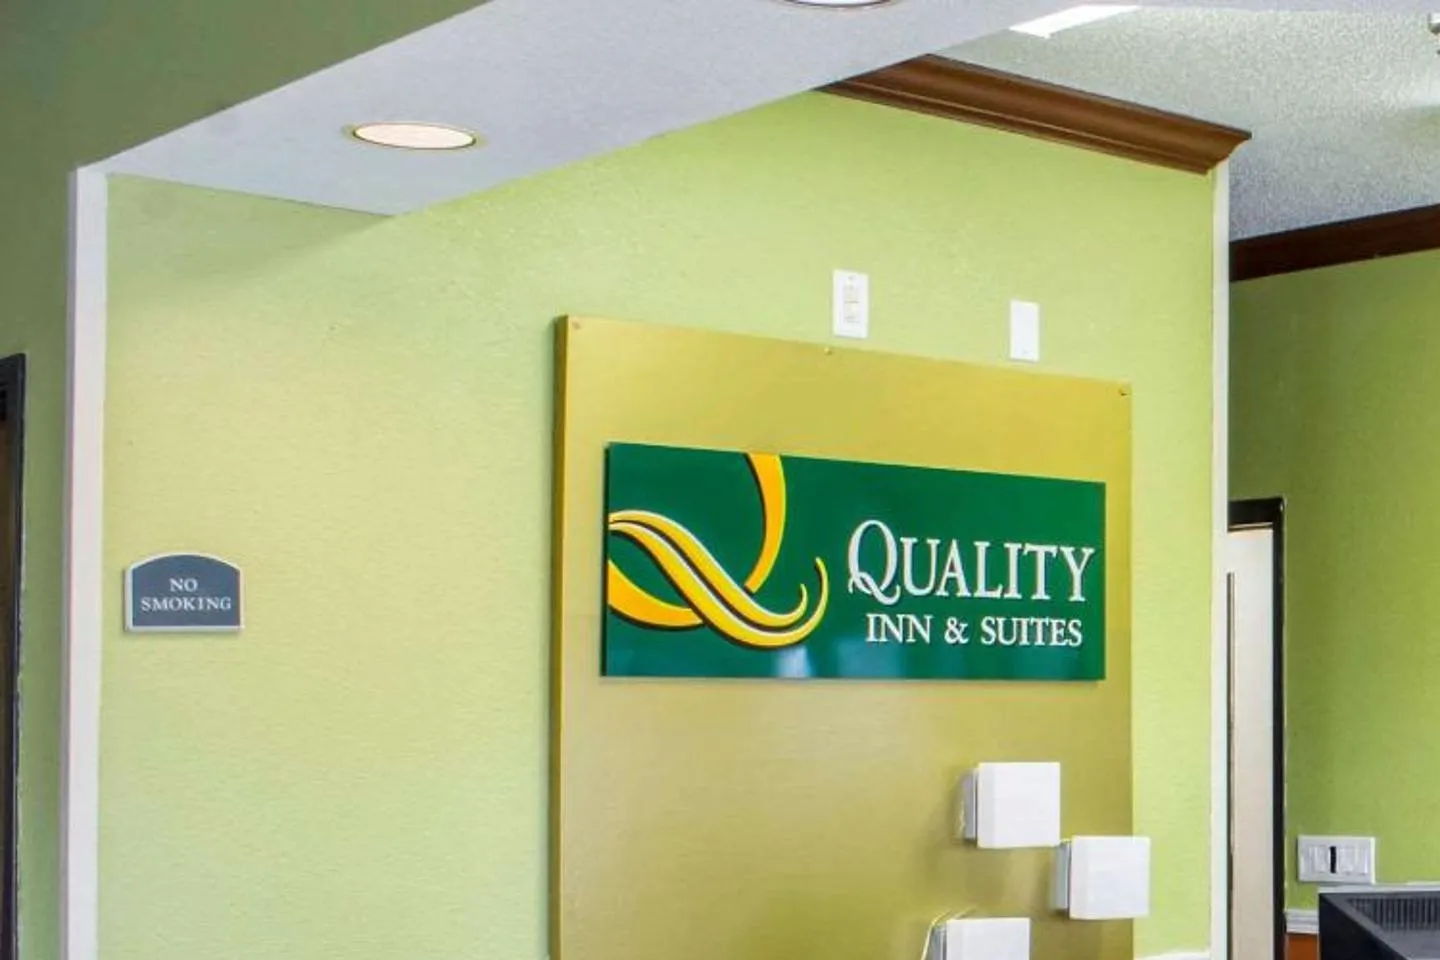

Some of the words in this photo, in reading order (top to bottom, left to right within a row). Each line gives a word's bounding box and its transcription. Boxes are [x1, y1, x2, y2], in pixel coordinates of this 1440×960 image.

[847, 519, 1095, 606] QUALITY
[169, 577, 198, 593] NO
[140, 596, 231, 612] SMOKING
[865, 613, 933, 644] INN
[944, 617, 969, 645] &
[981, 616, 1083, 647] SUITES
